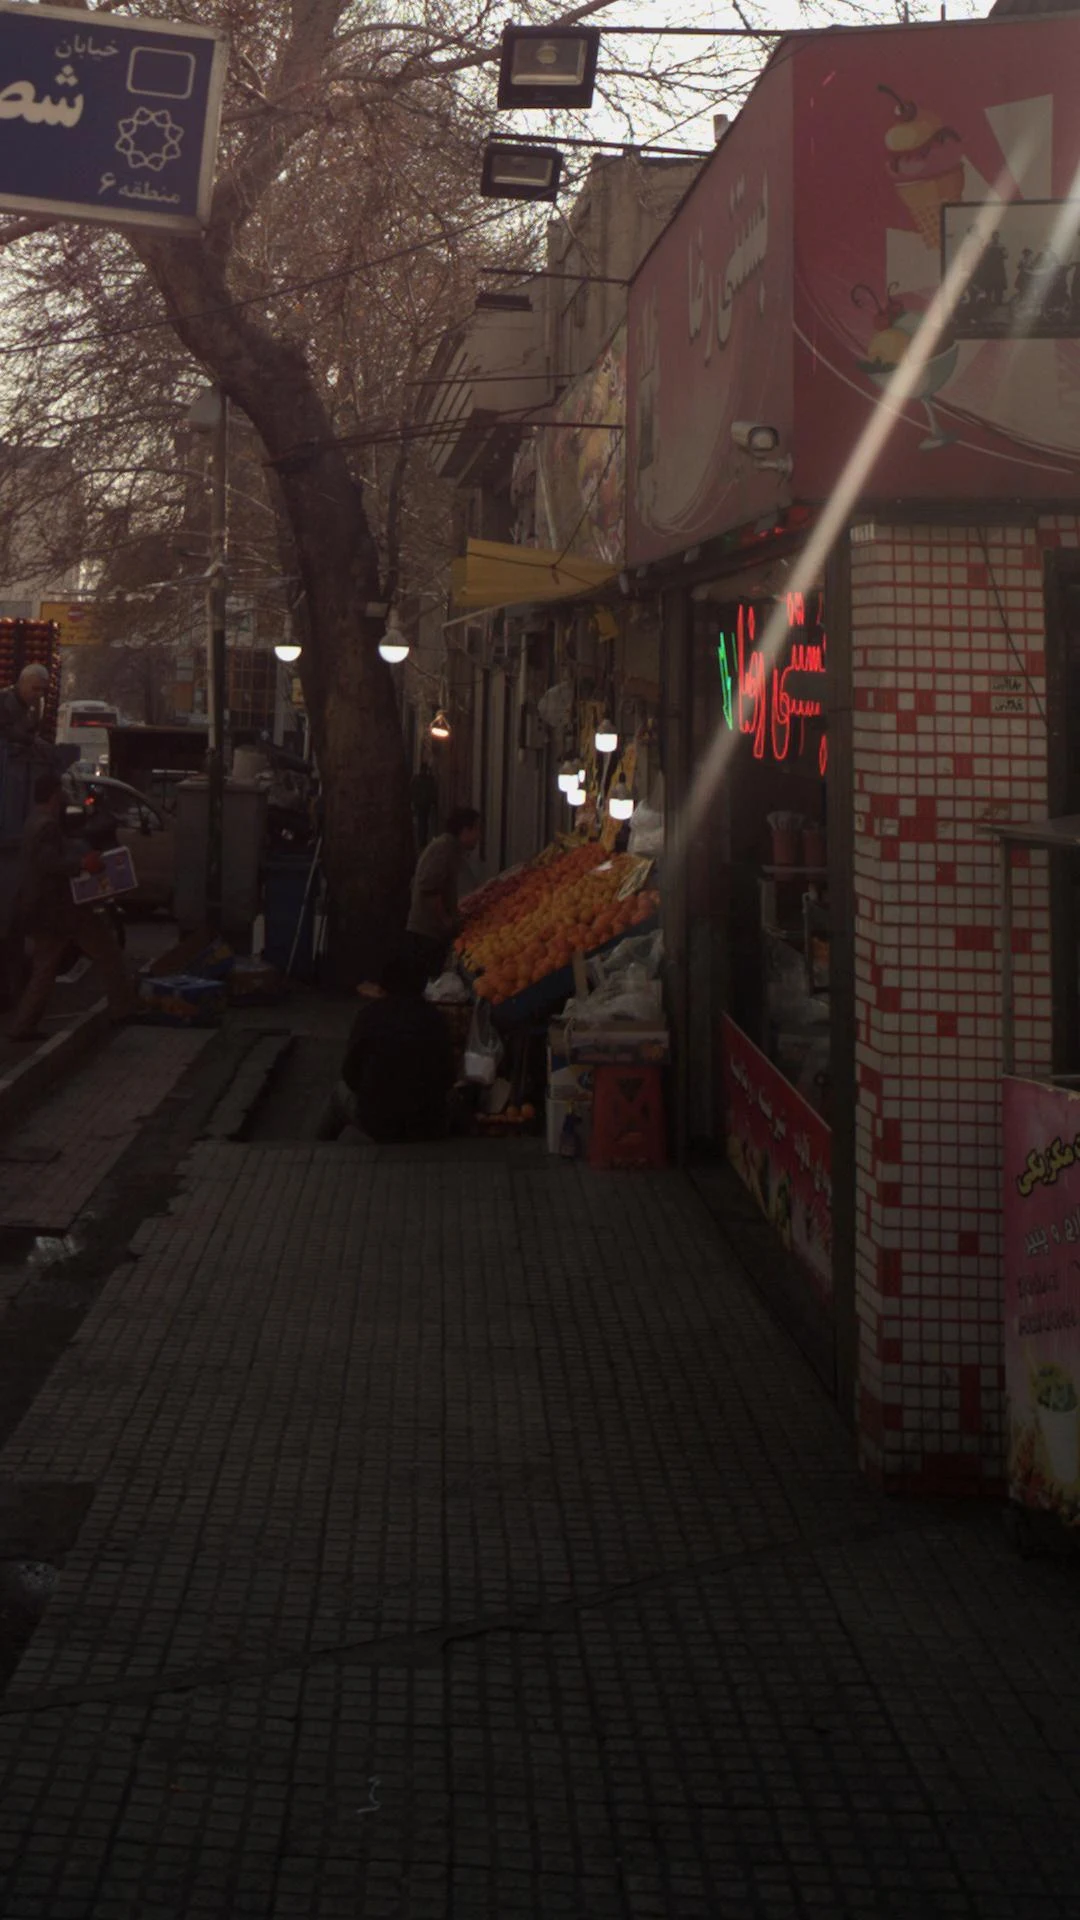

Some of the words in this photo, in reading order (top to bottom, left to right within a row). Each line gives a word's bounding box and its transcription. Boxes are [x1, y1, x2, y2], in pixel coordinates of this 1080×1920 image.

[54, 34, 119, 60] خیابان
[118, 180, 181, 204] منطقه
[717, 168, 769, 346] بستنی
[688, 222, 715, 366] رضا
[1016, 1136, 1074, 1197] مکزیکی
